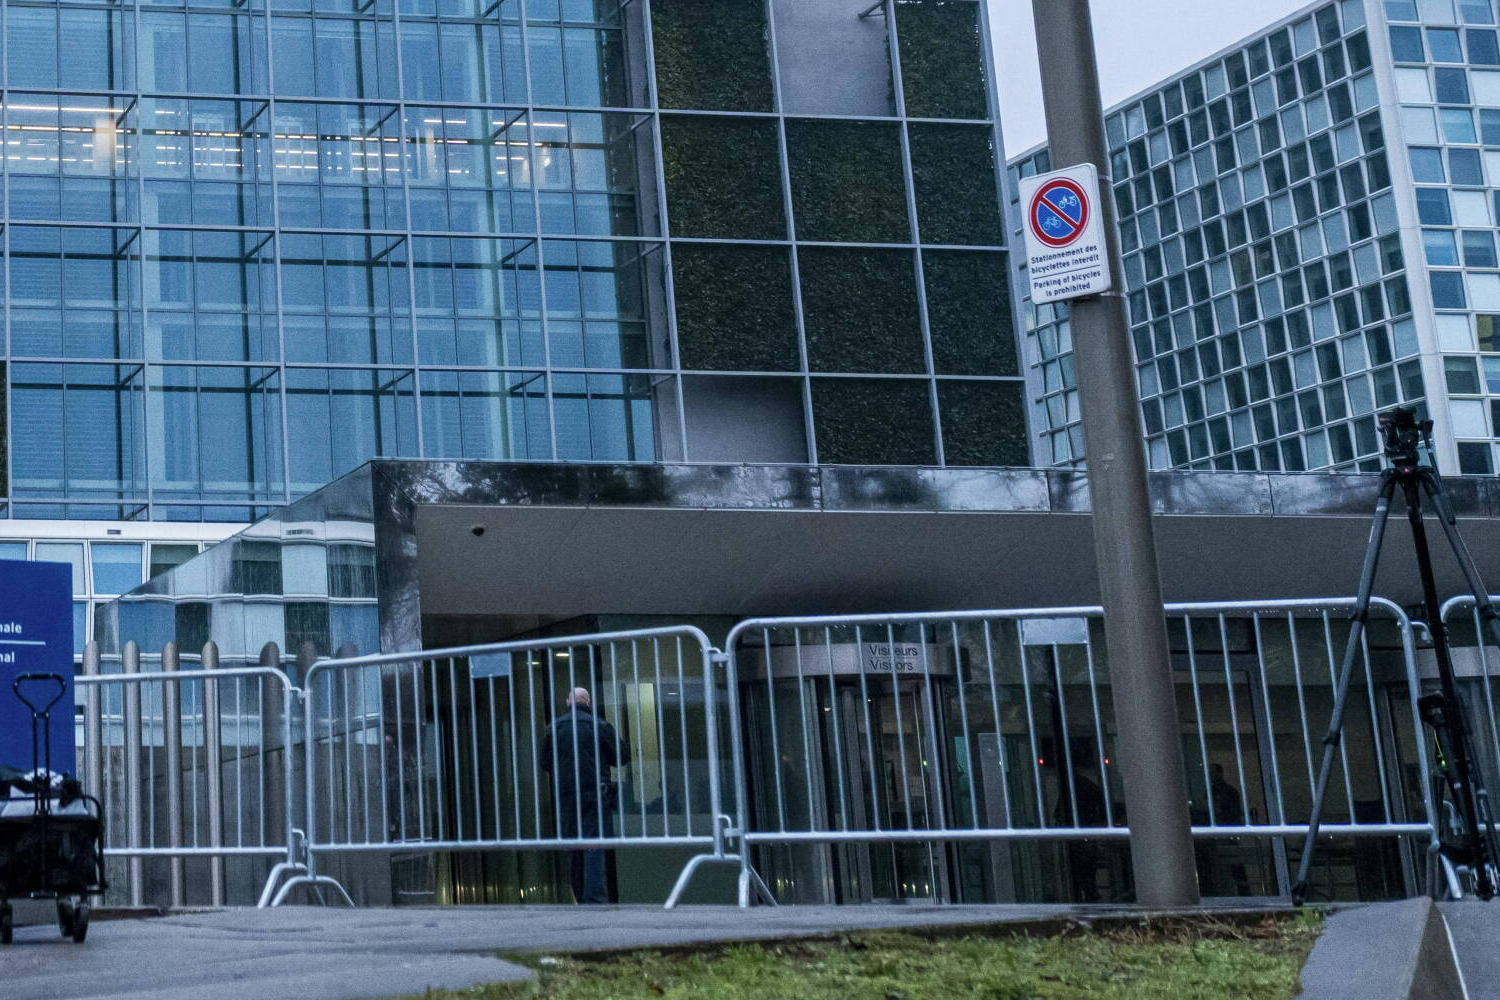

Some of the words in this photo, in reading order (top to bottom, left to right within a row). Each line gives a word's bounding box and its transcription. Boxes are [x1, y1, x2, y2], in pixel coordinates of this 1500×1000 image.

[1031, 247, 1083, 264] Stationnement
[1085, 244, 1097, 252] des
[1031, 261, 1070, 274] bicyclettes
[1072, 254, 1099, 265] interdit
[1033, 279, 1061, 289] Parking
[1063, 275, 1070, 283] of
[1071, 271, 1101, 281] bicycles
[1054, 281, 1090, 296] prohibited
[869, 644, 918, 656] Visieurs
[870, 660, 913, 671] Visiors
